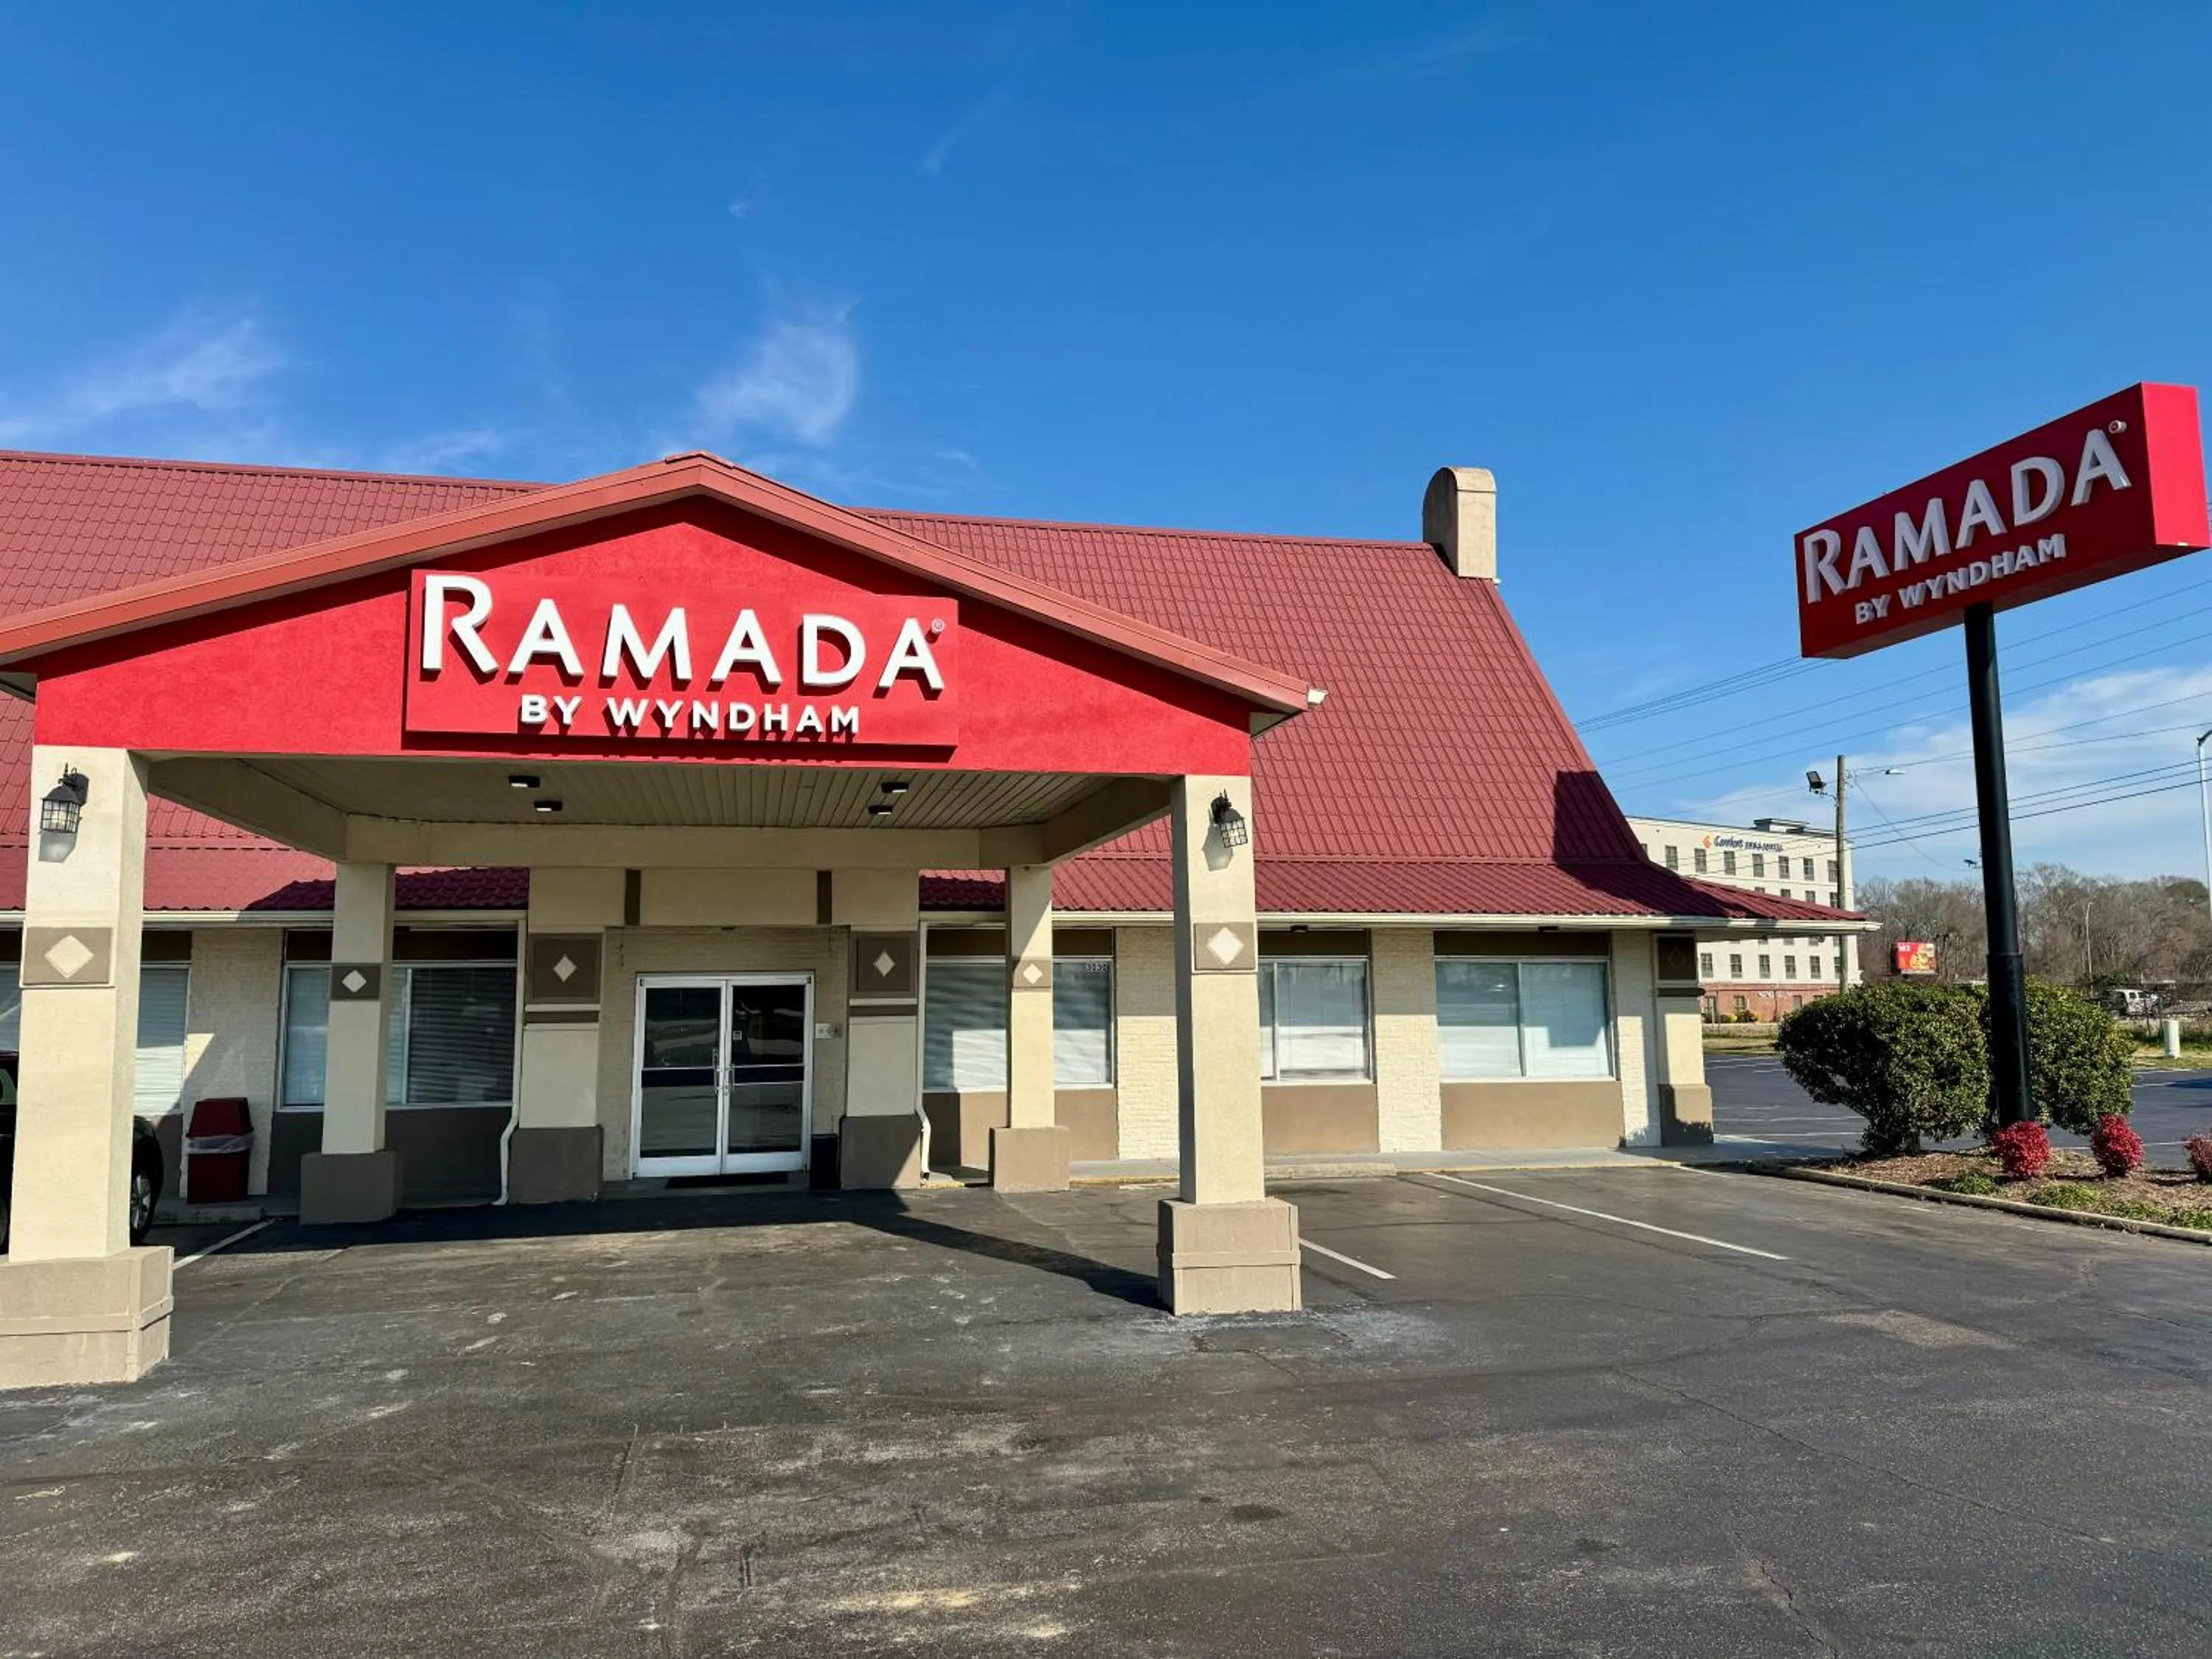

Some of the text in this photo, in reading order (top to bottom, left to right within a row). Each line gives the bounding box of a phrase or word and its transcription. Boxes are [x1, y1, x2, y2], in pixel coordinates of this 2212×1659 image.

[1804, 428, 2132, 603] RAMADA
[1855, 534, 2066, 625] BY WYNDHAM
[421, 574, 945, 690] RAMADA
[520, 693, 860, 734] BY WYNDHAM
